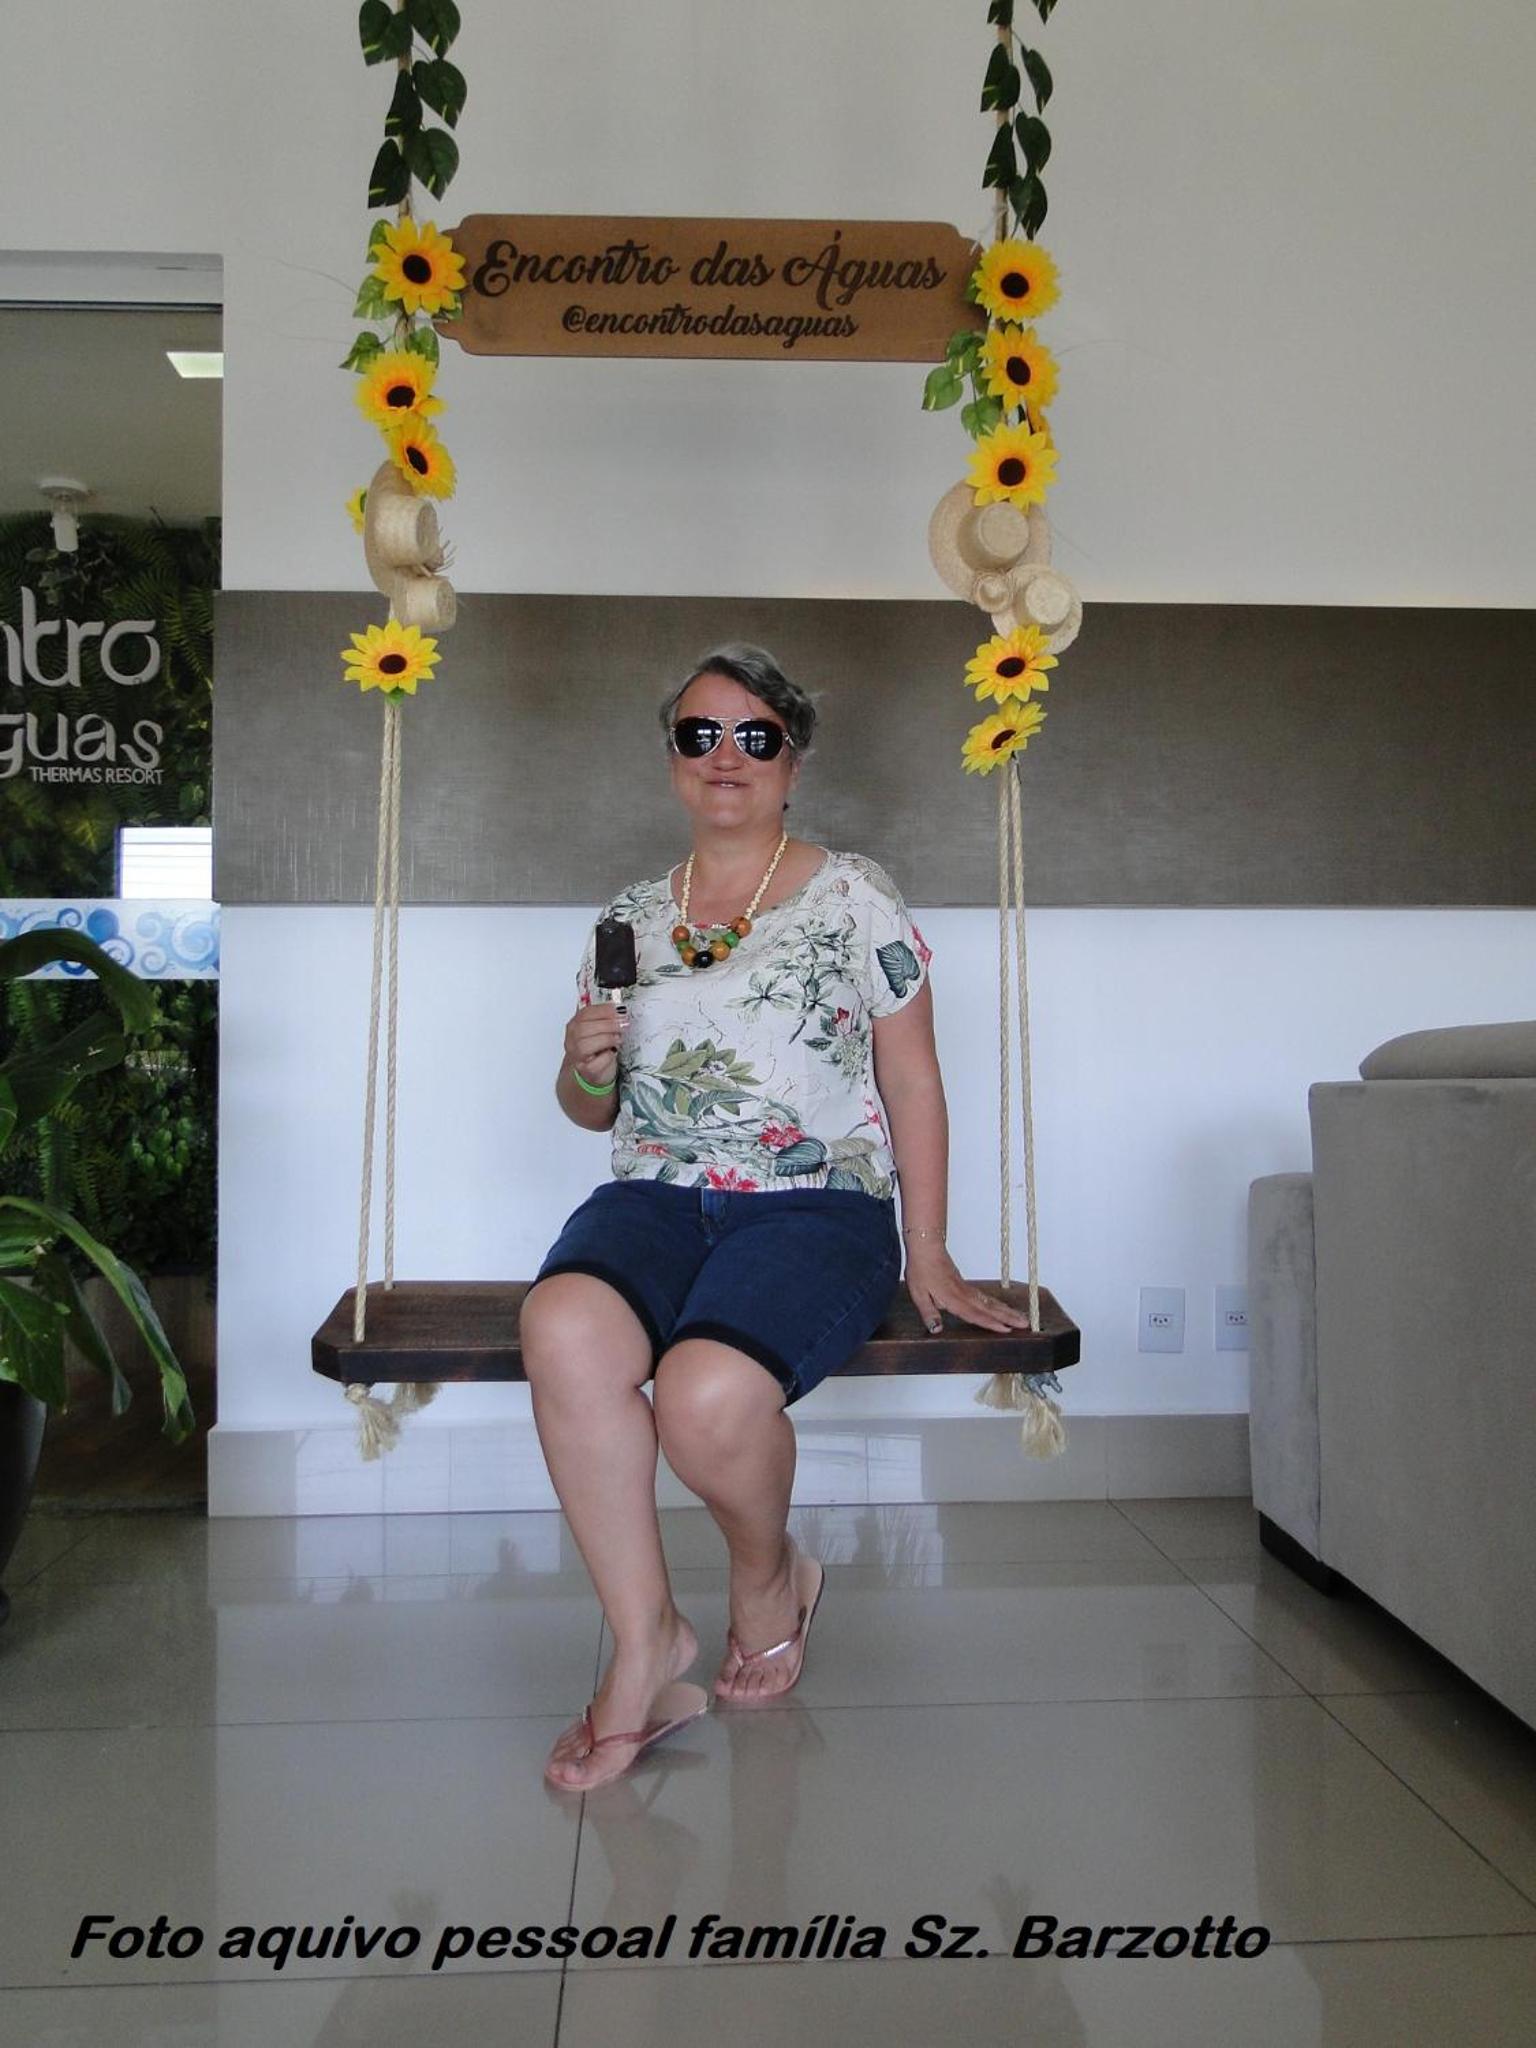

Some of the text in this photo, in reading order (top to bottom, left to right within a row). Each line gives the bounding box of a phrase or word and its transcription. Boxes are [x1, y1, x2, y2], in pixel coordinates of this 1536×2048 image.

[473, 231, 947, 310] Encontro das Águas
[562, 303, 859, 348] @encontrodasaguas
[29, 766, 164, 785] THERMAS RESORT
